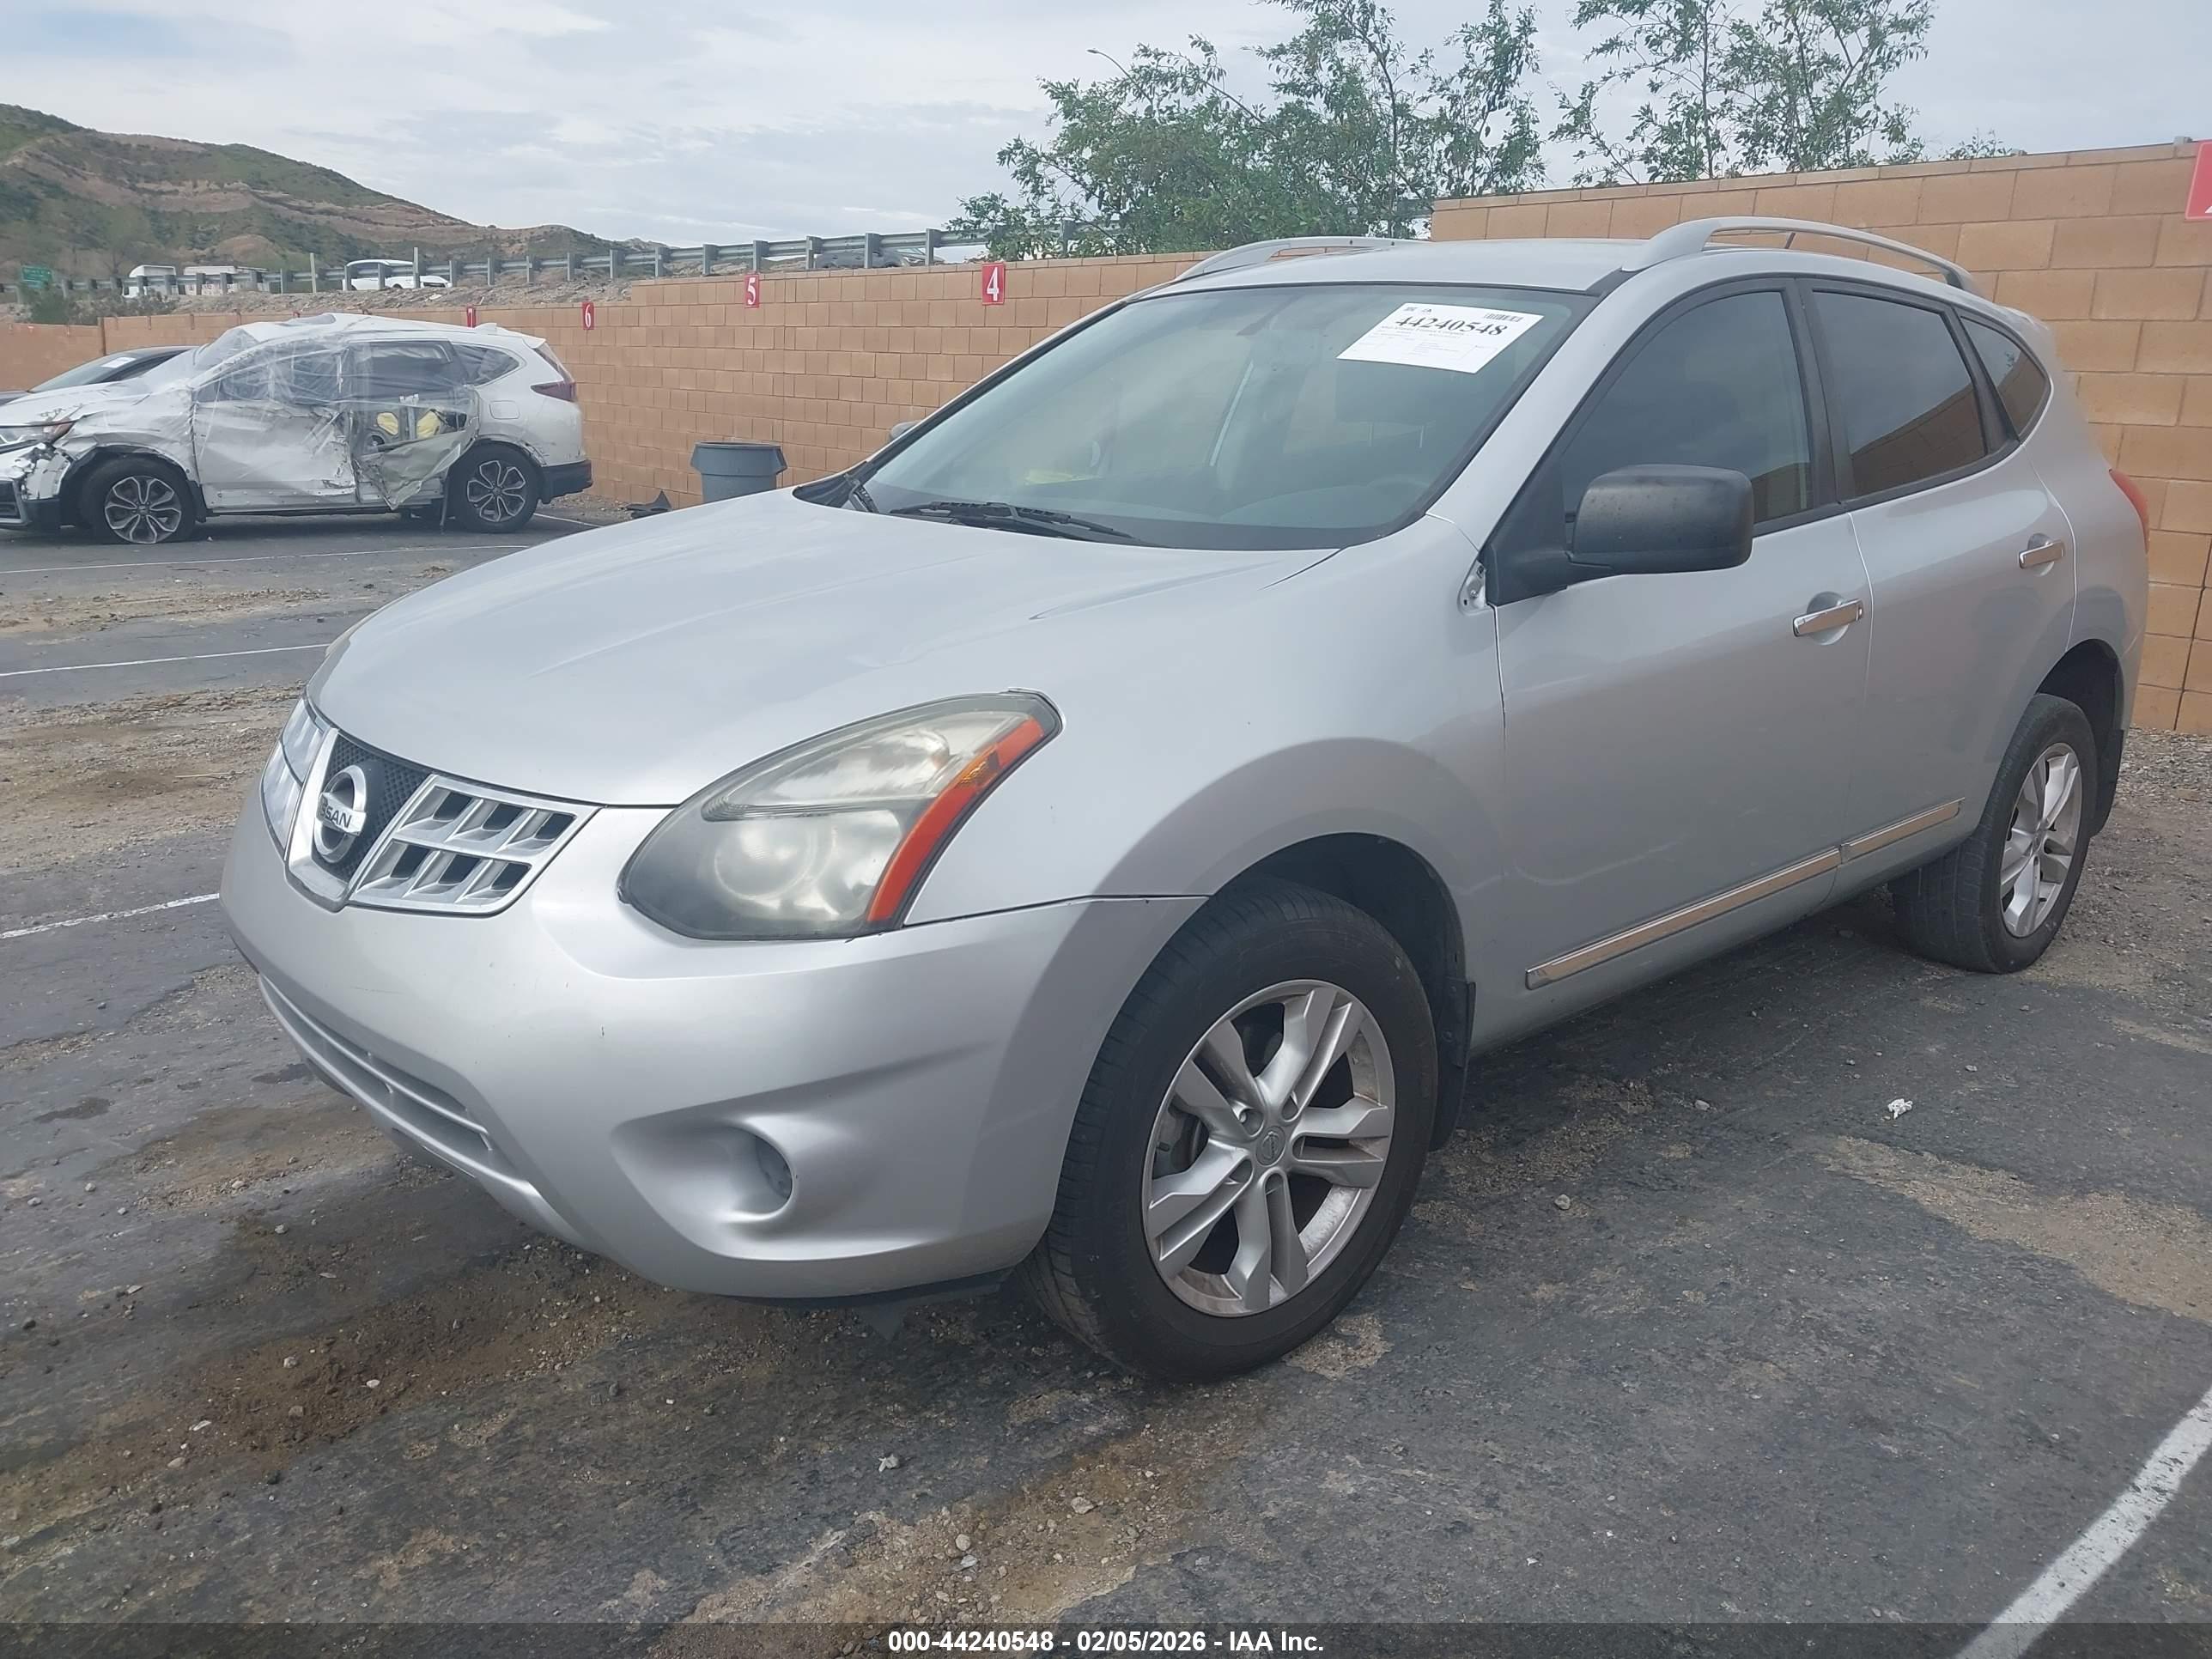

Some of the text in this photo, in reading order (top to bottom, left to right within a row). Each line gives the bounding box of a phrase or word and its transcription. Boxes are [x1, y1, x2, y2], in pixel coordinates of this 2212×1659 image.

[747, 276, 756, 305] 5
[987, 267, 1000, 301] 4
[585, 304, 592, 328] 6
[1395, 315, 1508, 336] 44240548
